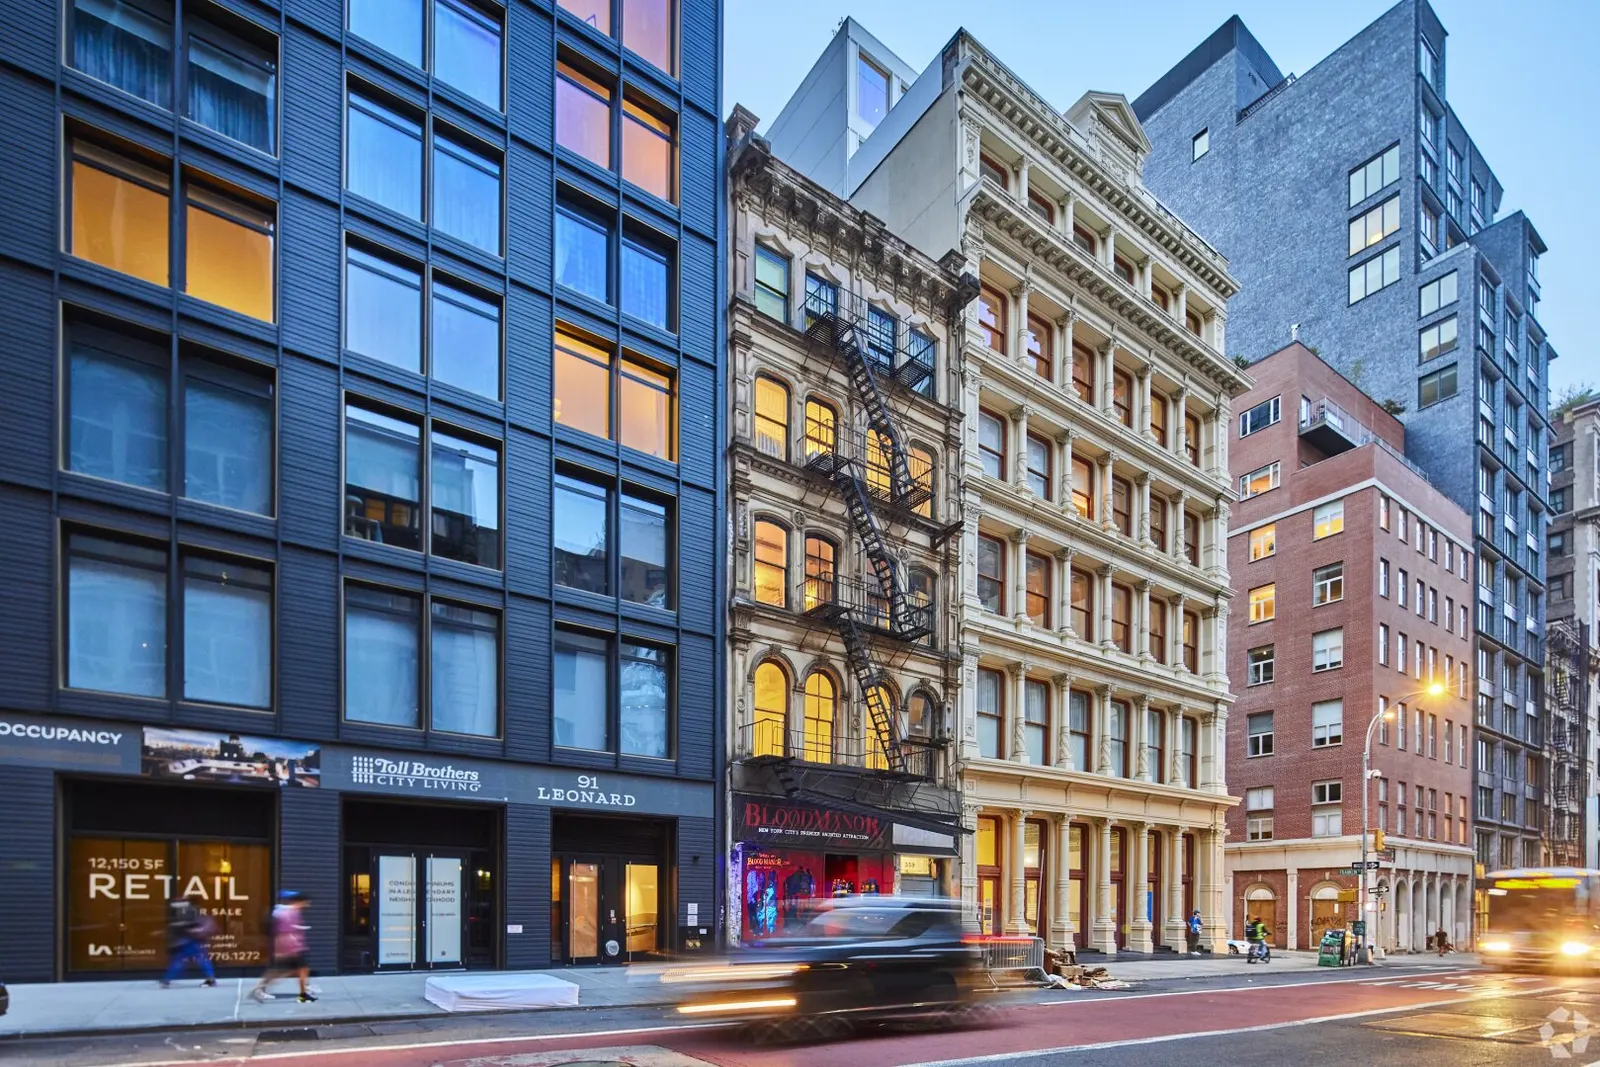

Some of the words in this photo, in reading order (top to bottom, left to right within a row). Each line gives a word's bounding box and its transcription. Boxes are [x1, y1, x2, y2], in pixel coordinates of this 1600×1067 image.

[0, 721, 123, 745] OCCUPANCY
[375, 758, 409, 775] Toll
[411, 762, 479, 781] Brothers
[377, 776, 416, 787] CITY
[424, 780, 480, 792] LIVING
[577, 775, 599, 789] 91
[537, 787, 636, 806] LEONARD
[88, 857, 140, 870] 12,150
[143, 858, 164, 870] SF
[88, 873, 249, 901] RETAIL
[211, 907, 243, 917] SALE
